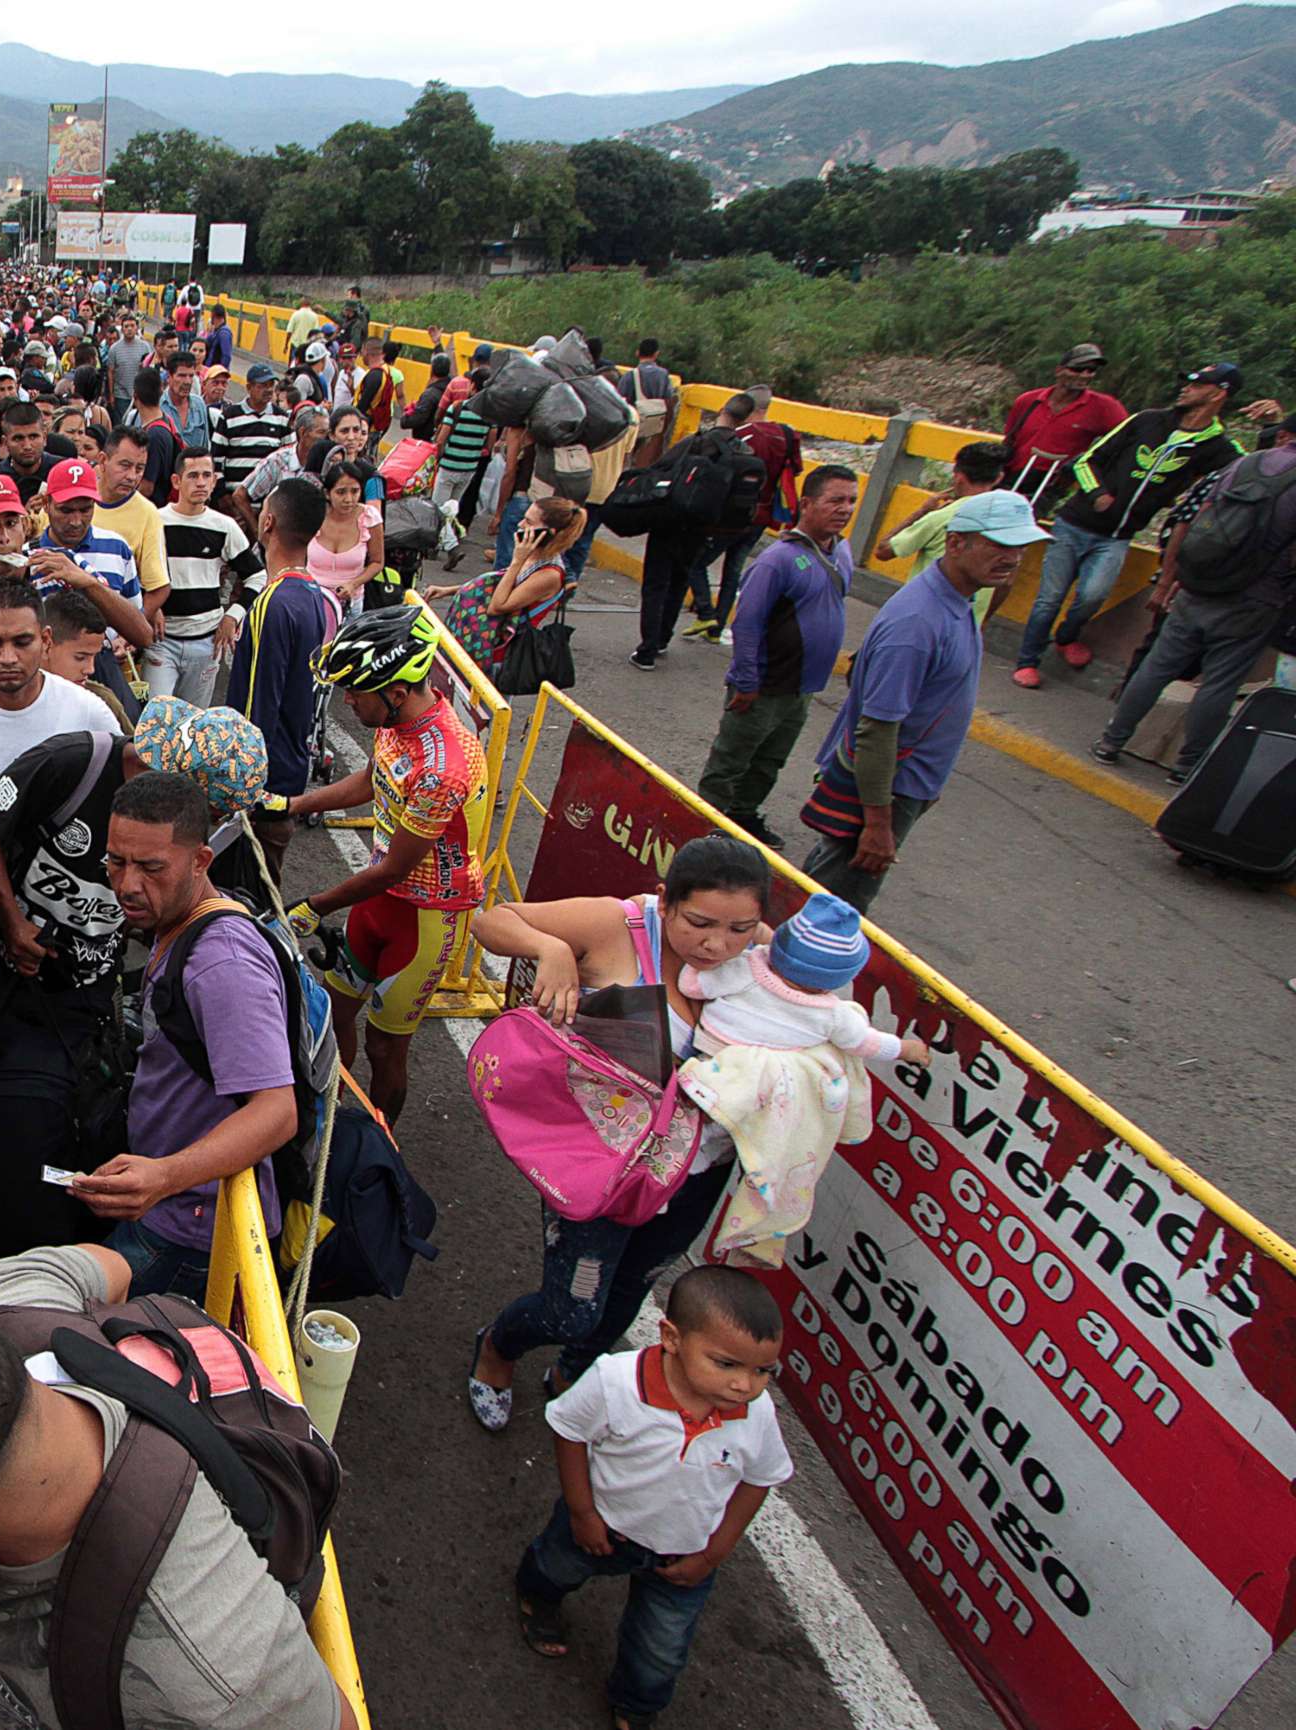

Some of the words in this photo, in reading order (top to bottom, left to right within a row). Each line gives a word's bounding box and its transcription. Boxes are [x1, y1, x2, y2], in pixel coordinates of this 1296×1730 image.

[67, 465, 84, 485] P
[370, 643, 407, 672] KASK
[871, 1160, 903, 1200] a
[907, 1191, 1028, 1327] 8:00
[1024, 1330, 1127, 1447] pm
[876, 1096, 941, 1175] De
[948, 1168, 1076, 1303] 6:00
[1077, 1309, 1184, 1428] am
[894, 1060, 933, 1100] a
[952, 1078, 1222, 1368] Viernes
[786, 1348, 813, 1386] a
[818, 1382, 906, 1522] 9:00
[907, 1529, 994, 1646] pm
[791, 1291, 842, 1368] De
[847, 1369, 943, 1509] 6:00
[946, 1519, 1037, 1639] am
[793, 1235, 828, 1270] y
[830, 1267, 1092, 1618] Domingo
[846, 1229, 1066, 1516] Sábado
